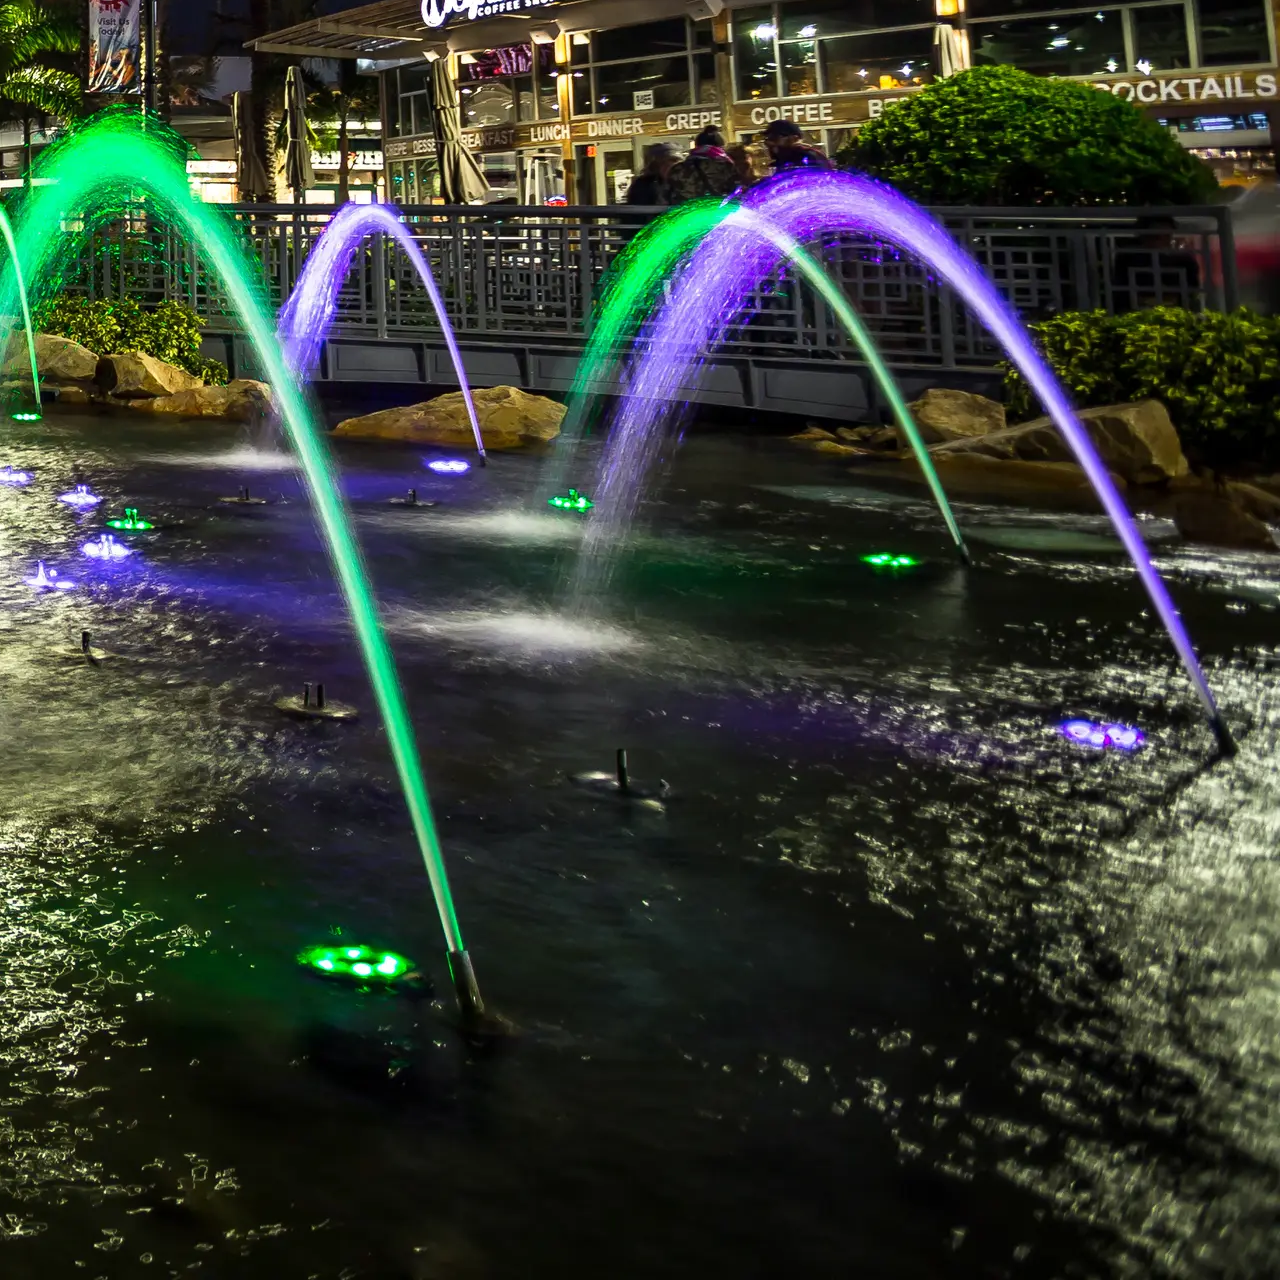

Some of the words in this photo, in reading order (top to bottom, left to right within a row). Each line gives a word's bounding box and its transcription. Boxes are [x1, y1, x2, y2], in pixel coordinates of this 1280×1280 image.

[477, 0, 521, 17] COFFEE
[385, 142, 408, 157] CREPE
[413, 138, 437, 154] DESSE
[461, 129, 515, 149] REAKFAST
[530, 124, 571, 142] LUNCH
[588, 118, 644, 137] DINNER
[665, 110, 722, 131] CREPE
[750, 102, 835, 125] COFFEE
